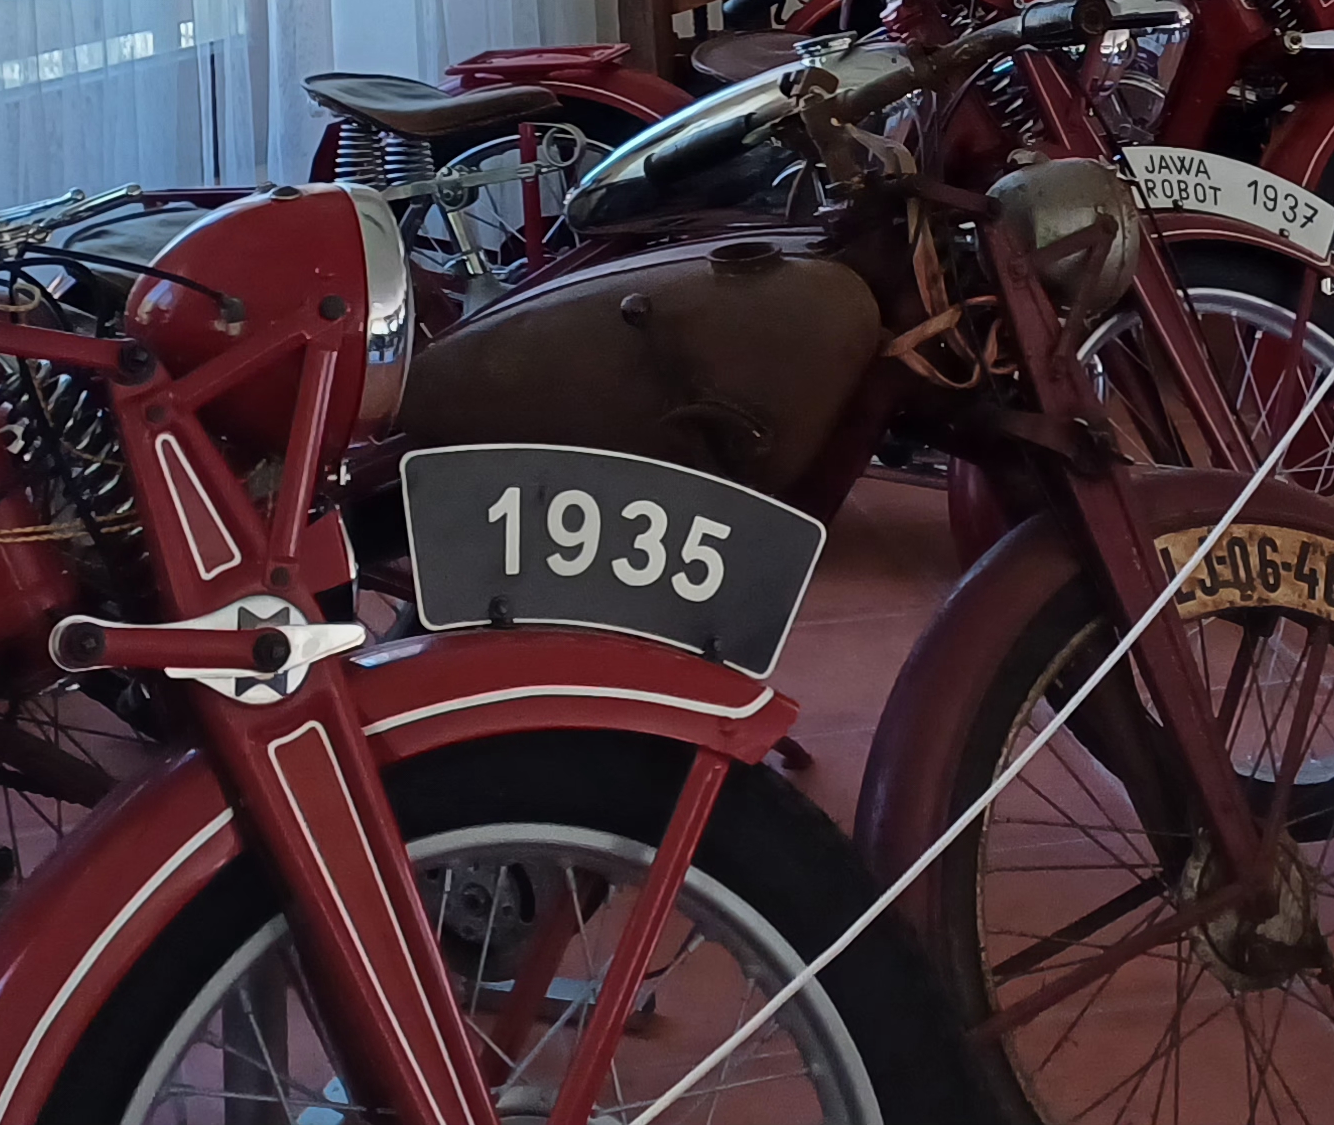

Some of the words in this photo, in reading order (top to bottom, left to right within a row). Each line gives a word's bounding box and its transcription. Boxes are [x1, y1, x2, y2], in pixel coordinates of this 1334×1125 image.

[1144, 154, 1212, 181] JAWA
[1247, 179, 1319, 229] 1937
[1144, 178, 1222, 206] ROBOT
[488, 486, 732, 602] 1935
